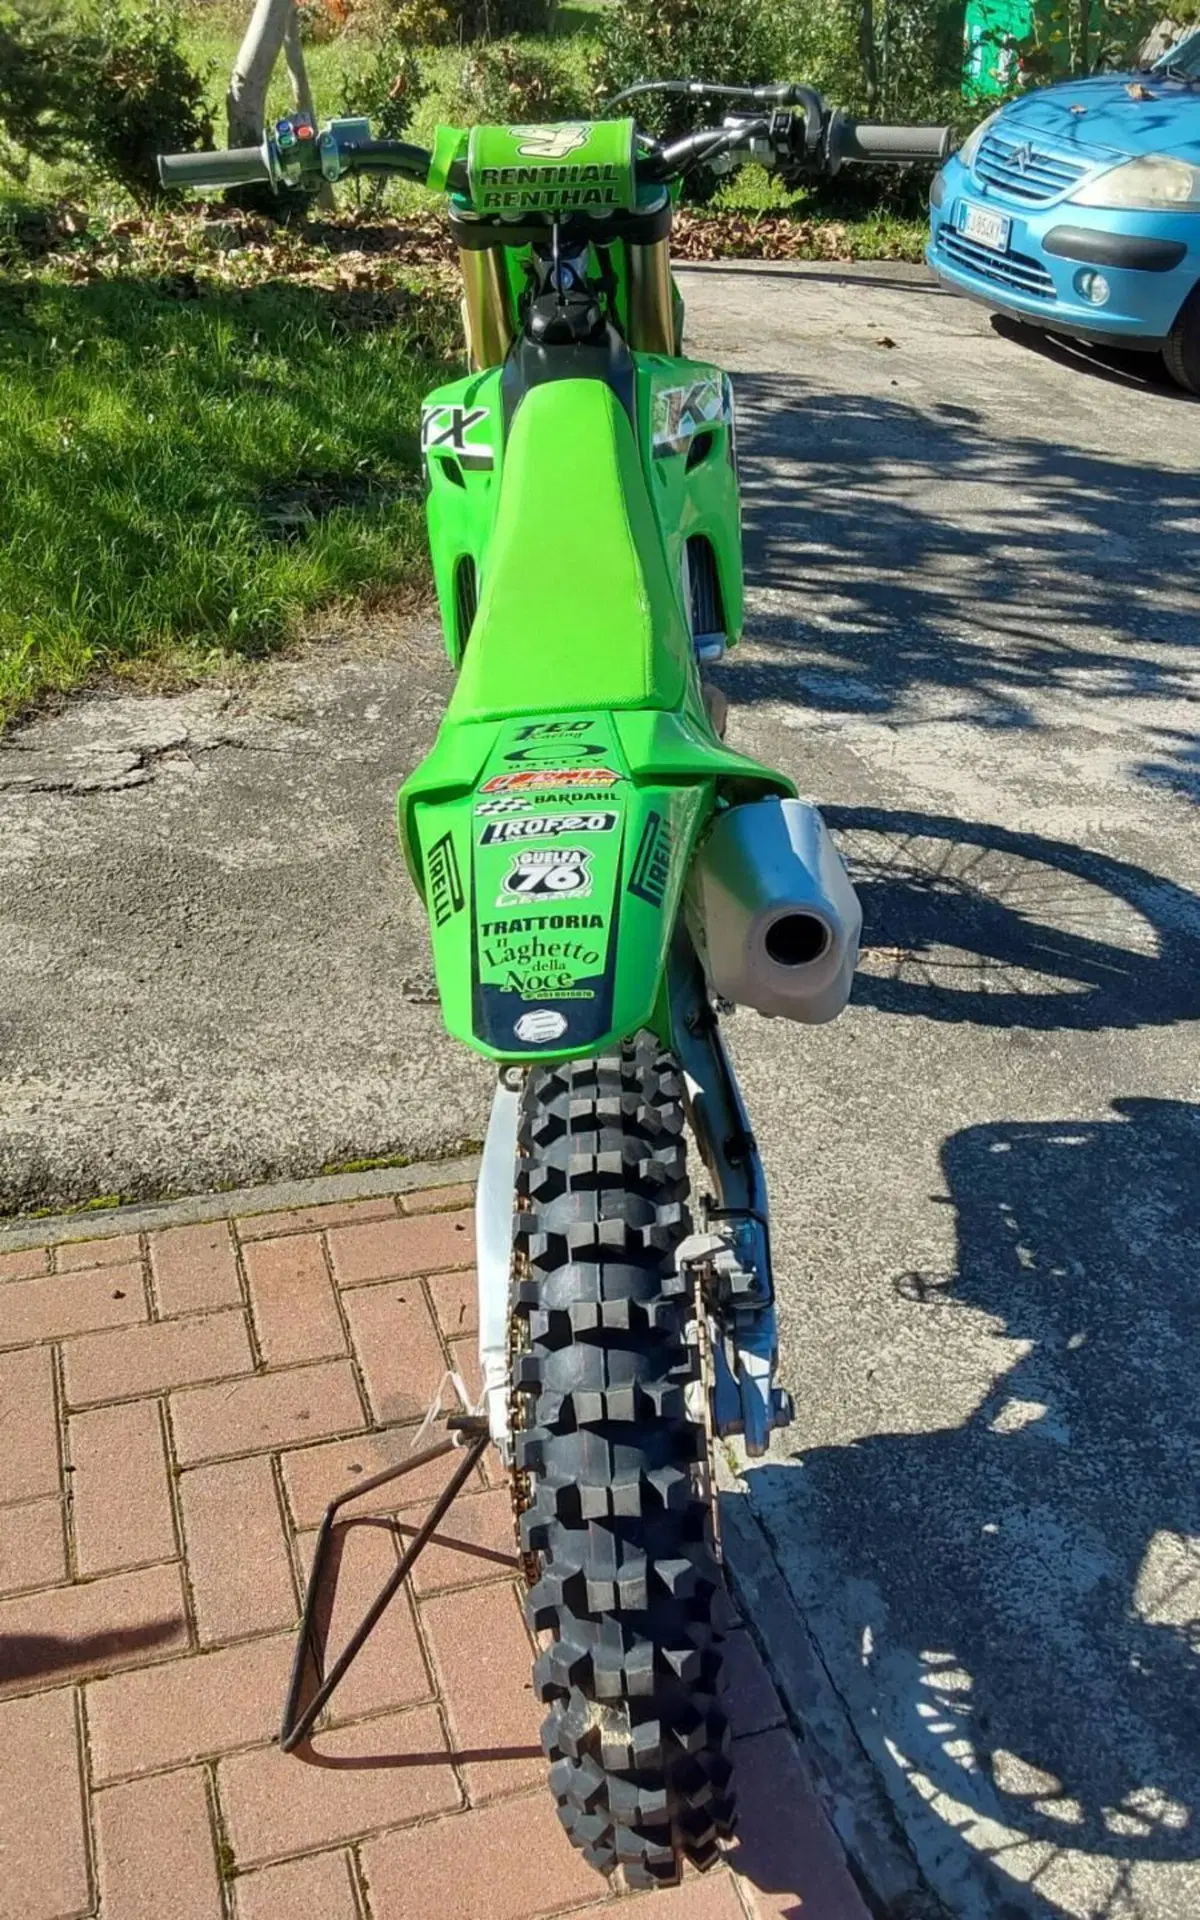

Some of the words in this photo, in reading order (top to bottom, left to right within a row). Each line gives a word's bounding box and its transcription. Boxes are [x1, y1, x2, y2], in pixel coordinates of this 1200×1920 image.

[481, 164, 619, 184] RENTHAL
[484, 188, 621, 207] RENTHAL
[513, 720, 595, 741] TED
[534, 792, 622, 806] BARDAHL
[427, 830, 466, 928] PIRELLI
[516, 865, 581, 891] 76
[481, 915, 604, 936] TRATTORIA
[483, 936, 600, 968] Laghetto
[532, 960, 566, 972] della
[501, 970, 572, 992] Noce
